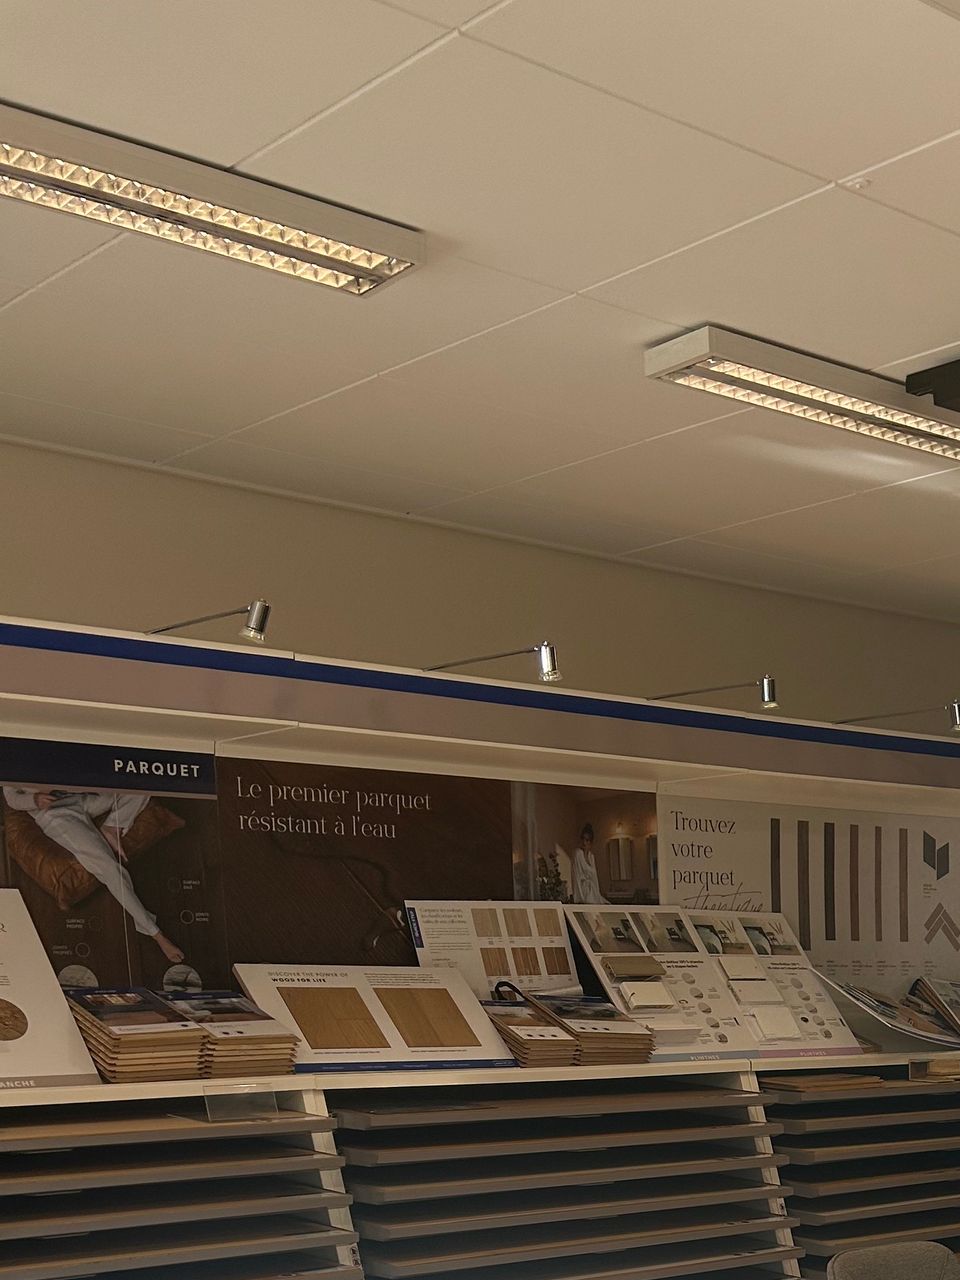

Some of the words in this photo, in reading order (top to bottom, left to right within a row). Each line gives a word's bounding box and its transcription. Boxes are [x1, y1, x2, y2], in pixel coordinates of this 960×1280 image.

[114, 759, 200, 778] PARQUET
[236, 776, 262, 798] Le
[269, 784, 350, 807] premier
[356, 791, 432, 815] parquet
[239, 810, 328, 835] résistant
[334, 816, 345, 836] à
[352, 815, 397, 839] l'eau
[670, 810, 737, 834] Trouvez
[671, 842, 714, 859] votre
[672, 869, 736, 891] parquet
